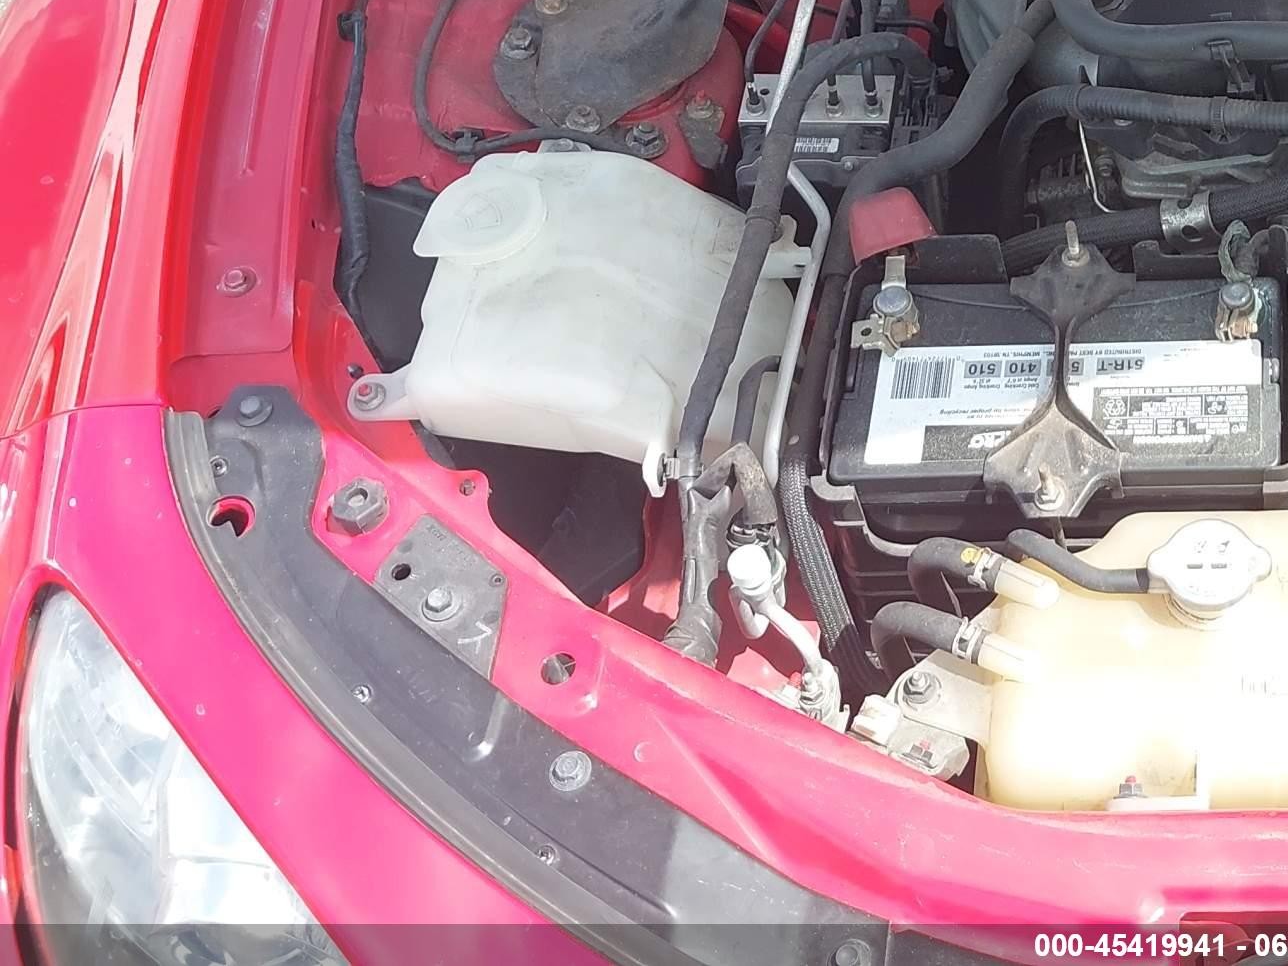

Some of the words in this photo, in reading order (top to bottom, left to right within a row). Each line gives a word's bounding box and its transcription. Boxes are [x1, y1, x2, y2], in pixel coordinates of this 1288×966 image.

[968, 363, 996, 375] 510
[1009, 362, 1037, 374] 410
[1097, 359, 1143, 372] 51R-T
